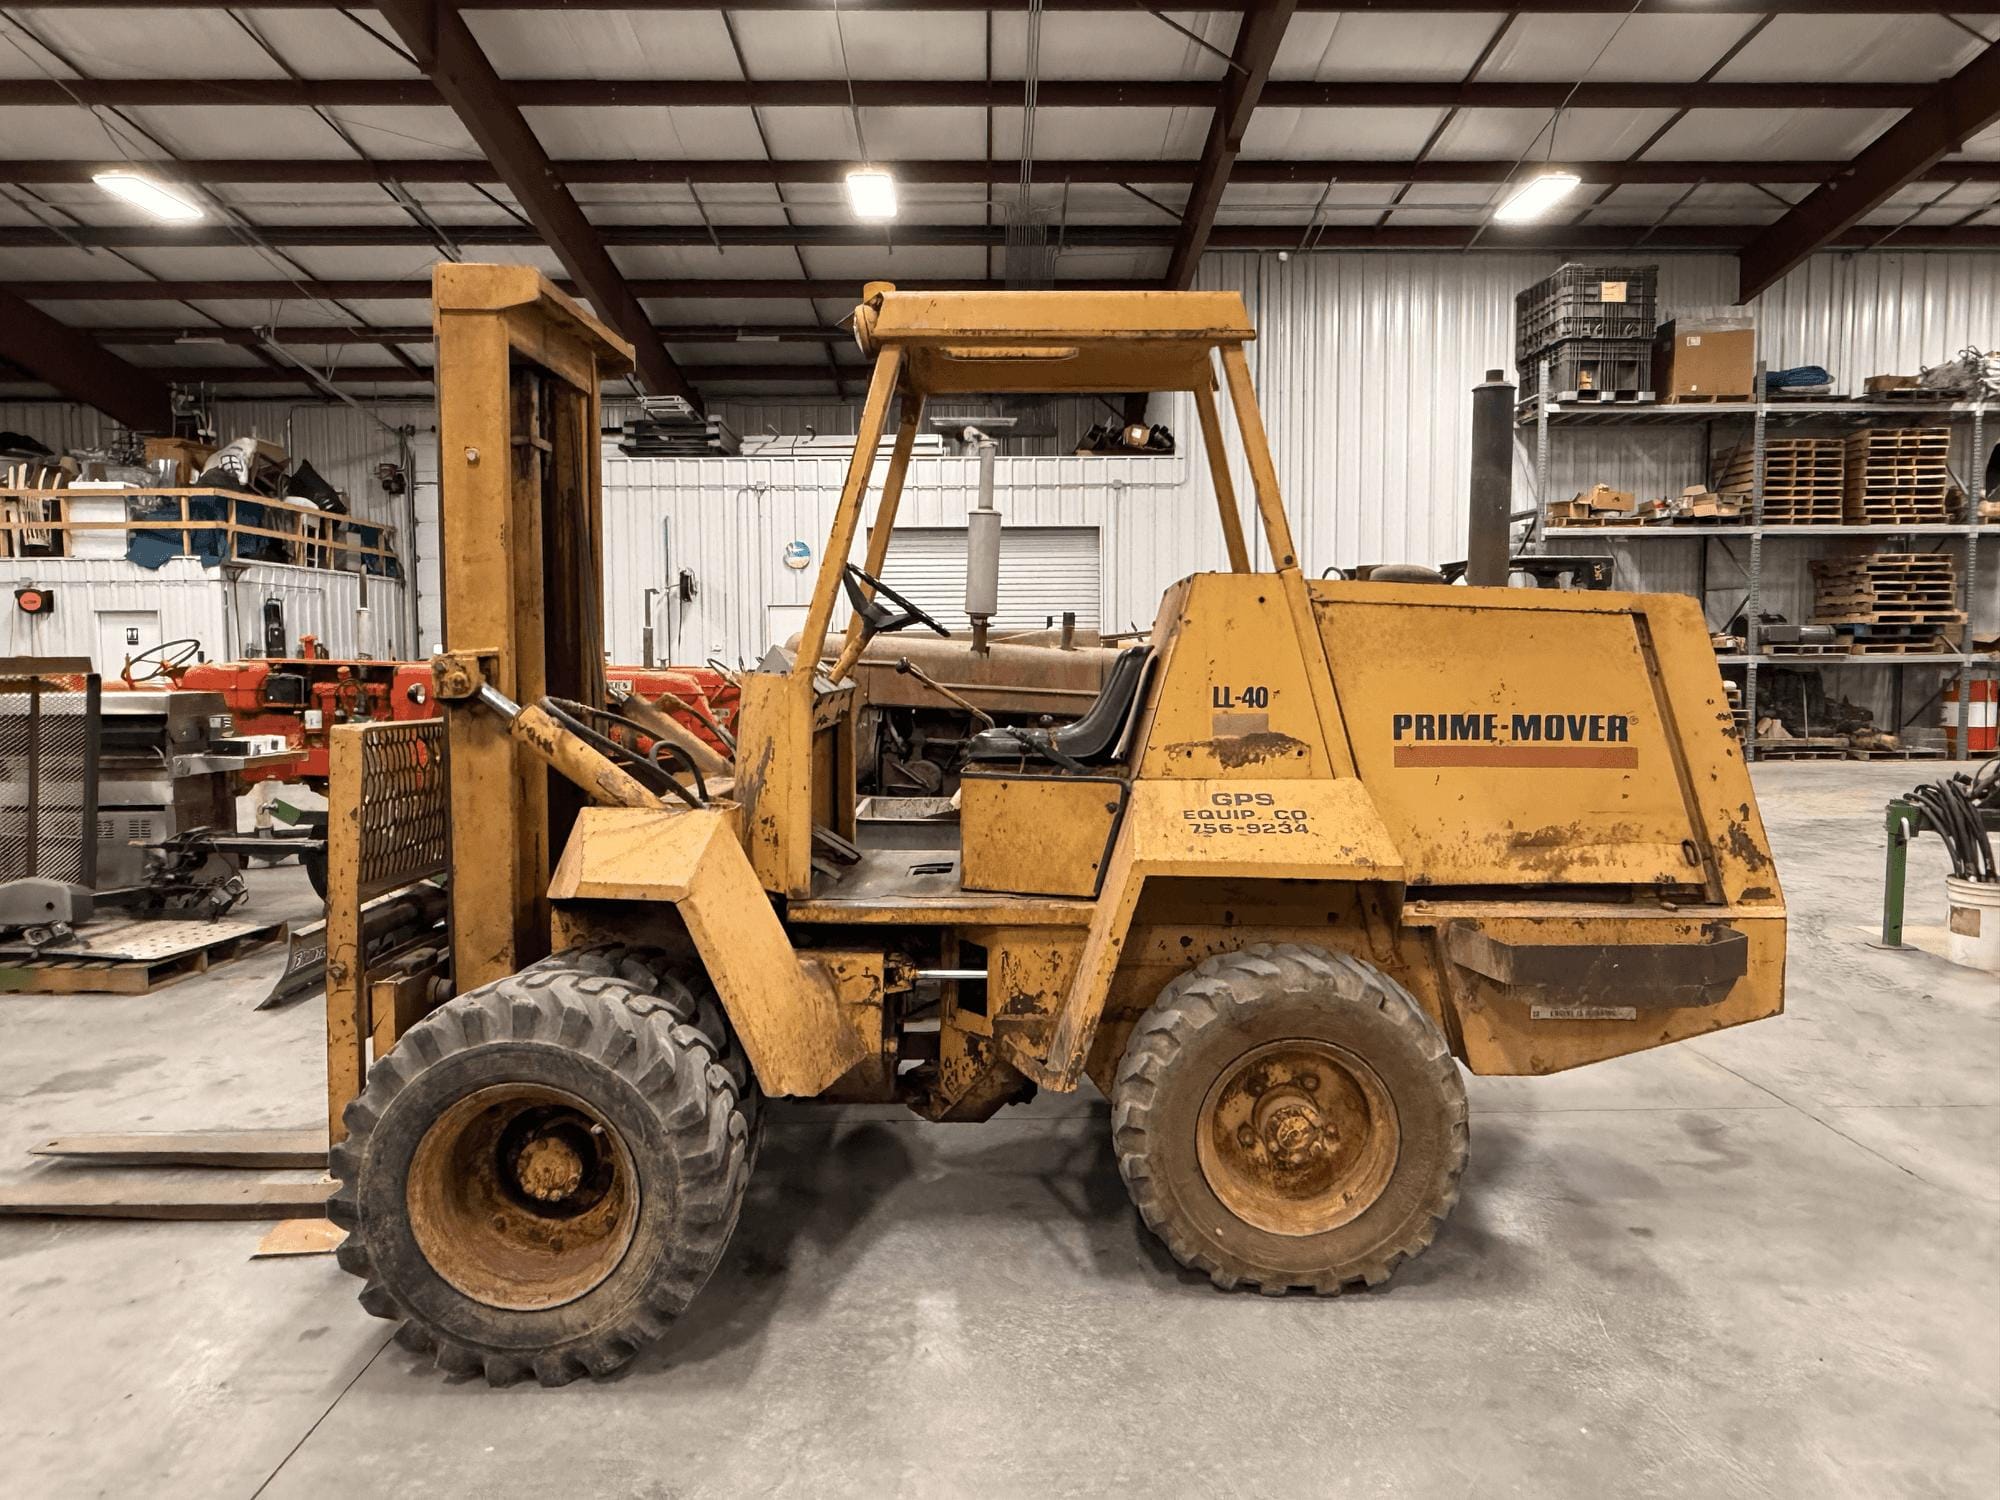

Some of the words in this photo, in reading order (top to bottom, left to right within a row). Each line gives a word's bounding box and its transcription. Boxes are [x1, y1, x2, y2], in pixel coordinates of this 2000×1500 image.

[1213, 686, 1269, 708] LL-40
[1211, 792, 1275, 806] GPS
[1189, 823, 1309, 834] 756-9234
